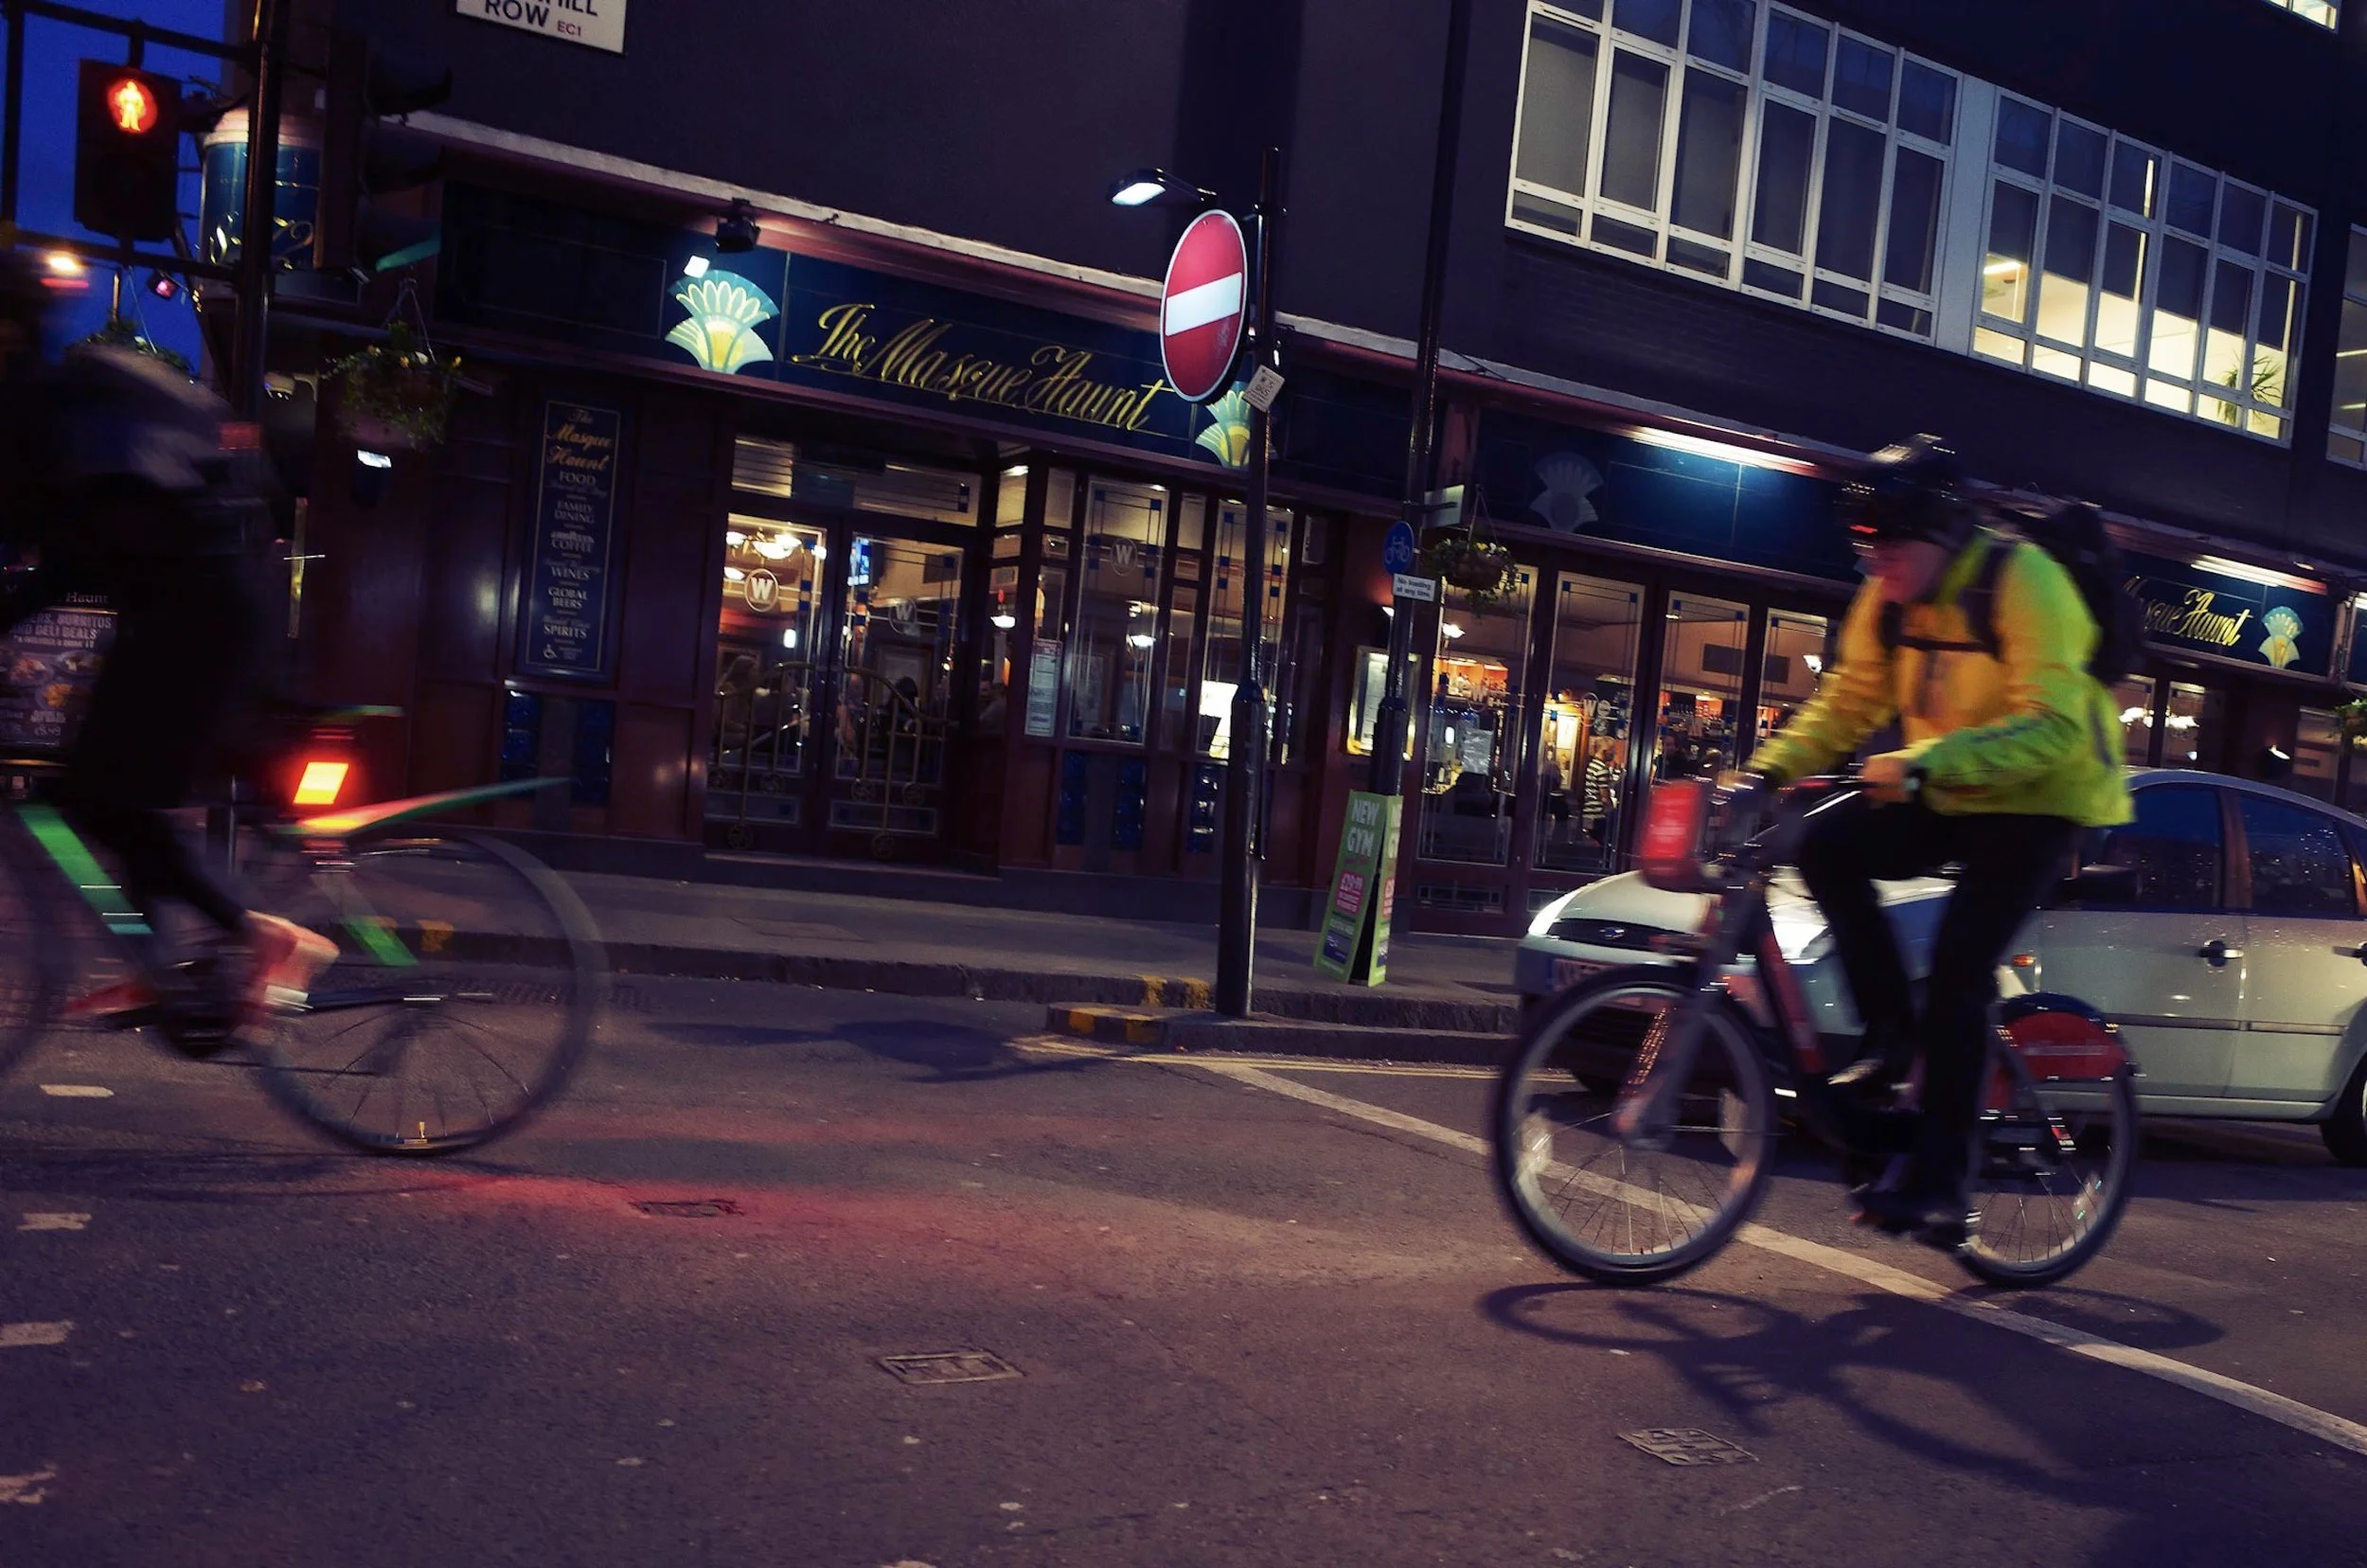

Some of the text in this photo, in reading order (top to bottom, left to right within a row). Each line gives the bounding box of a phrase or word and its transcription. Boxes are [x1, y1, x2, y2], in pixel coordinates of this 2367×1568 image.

[485, 0, 580, 36] ROW EC1
[793, 303, 877, 372] The
[860, 317, 1034, 407] Masque
[1024, 344, 1174, 432] Haunt
[559, 471, 596, 486] FOOD
[551, 566, 592, 581] WINES
[751, 577, 774, 601] W
[543, 624, 589, 640] SPIRITS
[2175, 587, 2253, 648] Haunt
[1351, 798, 1380, 827] NEW
[1346, 827, 1375, 858] GYM
